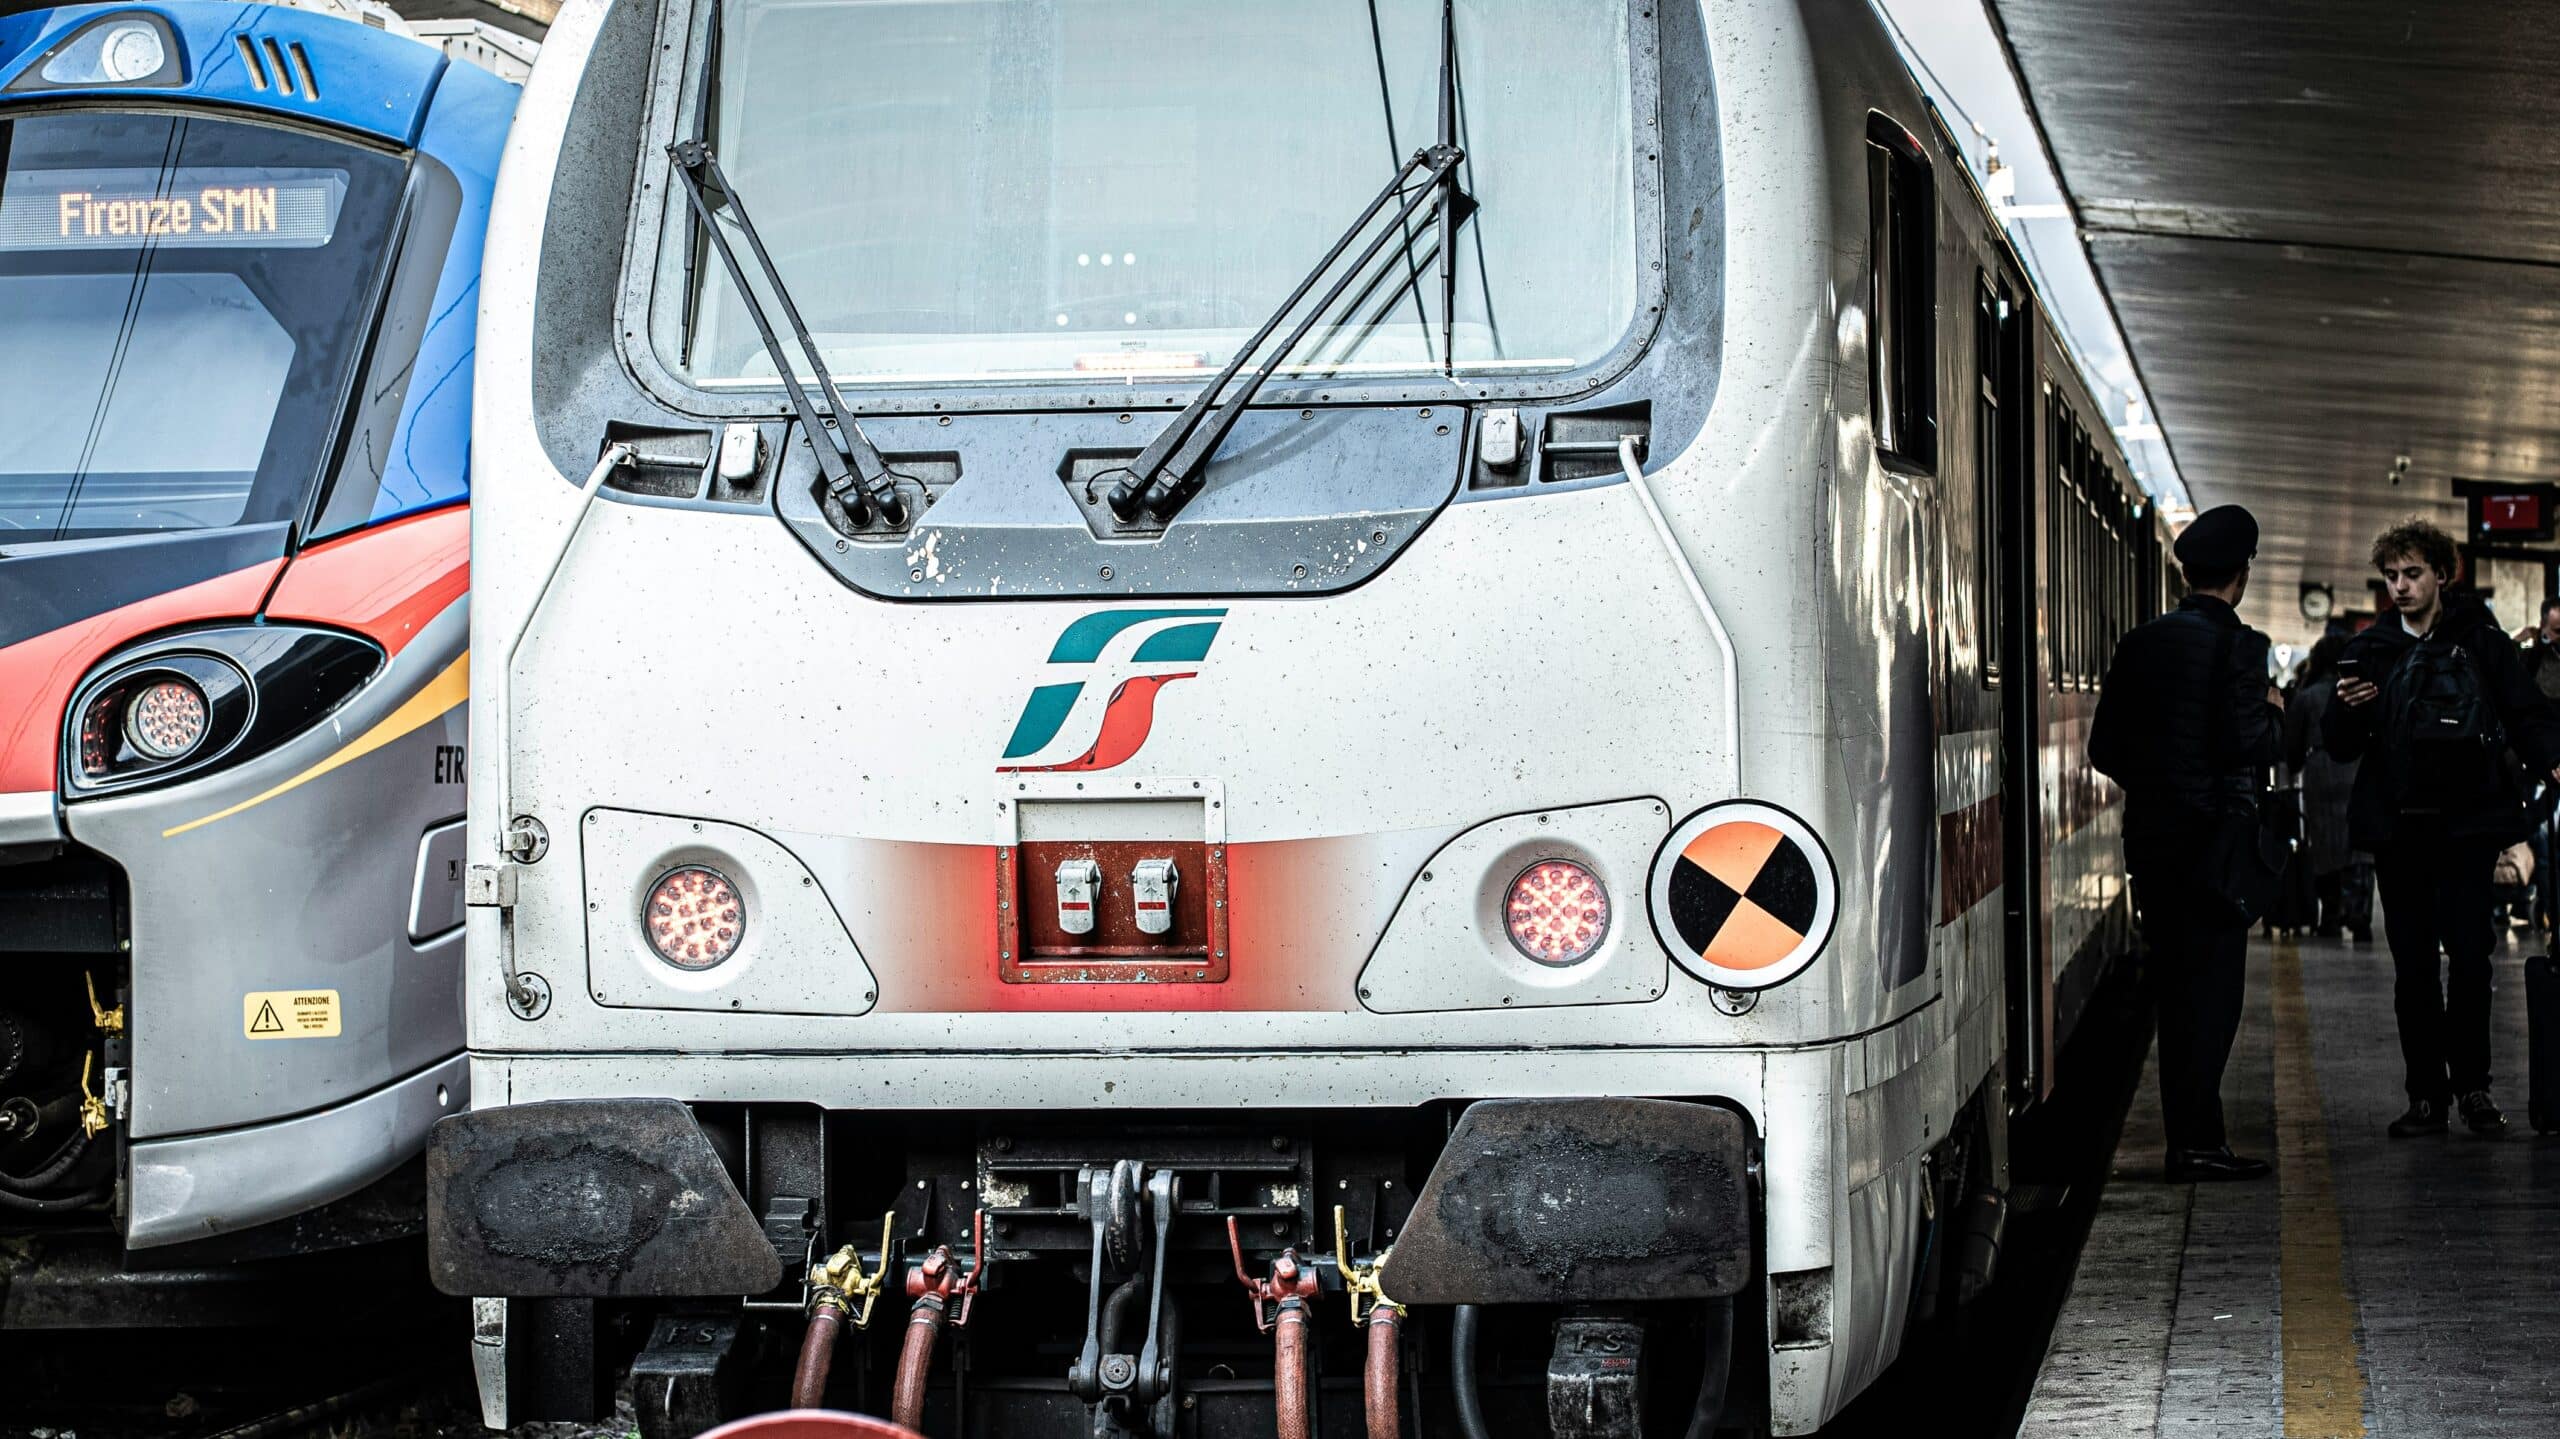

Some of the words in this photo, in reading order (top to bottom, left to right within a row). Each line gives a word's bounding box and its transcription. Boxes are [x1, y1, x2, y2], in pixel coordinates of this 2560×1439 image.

[59, 193, 191, 237] Firenze
[201, 187, 276, 234] SMN
[434, 745, 465, 784] ETR
[293, 996, 330, 1006] ATTENZIONE
